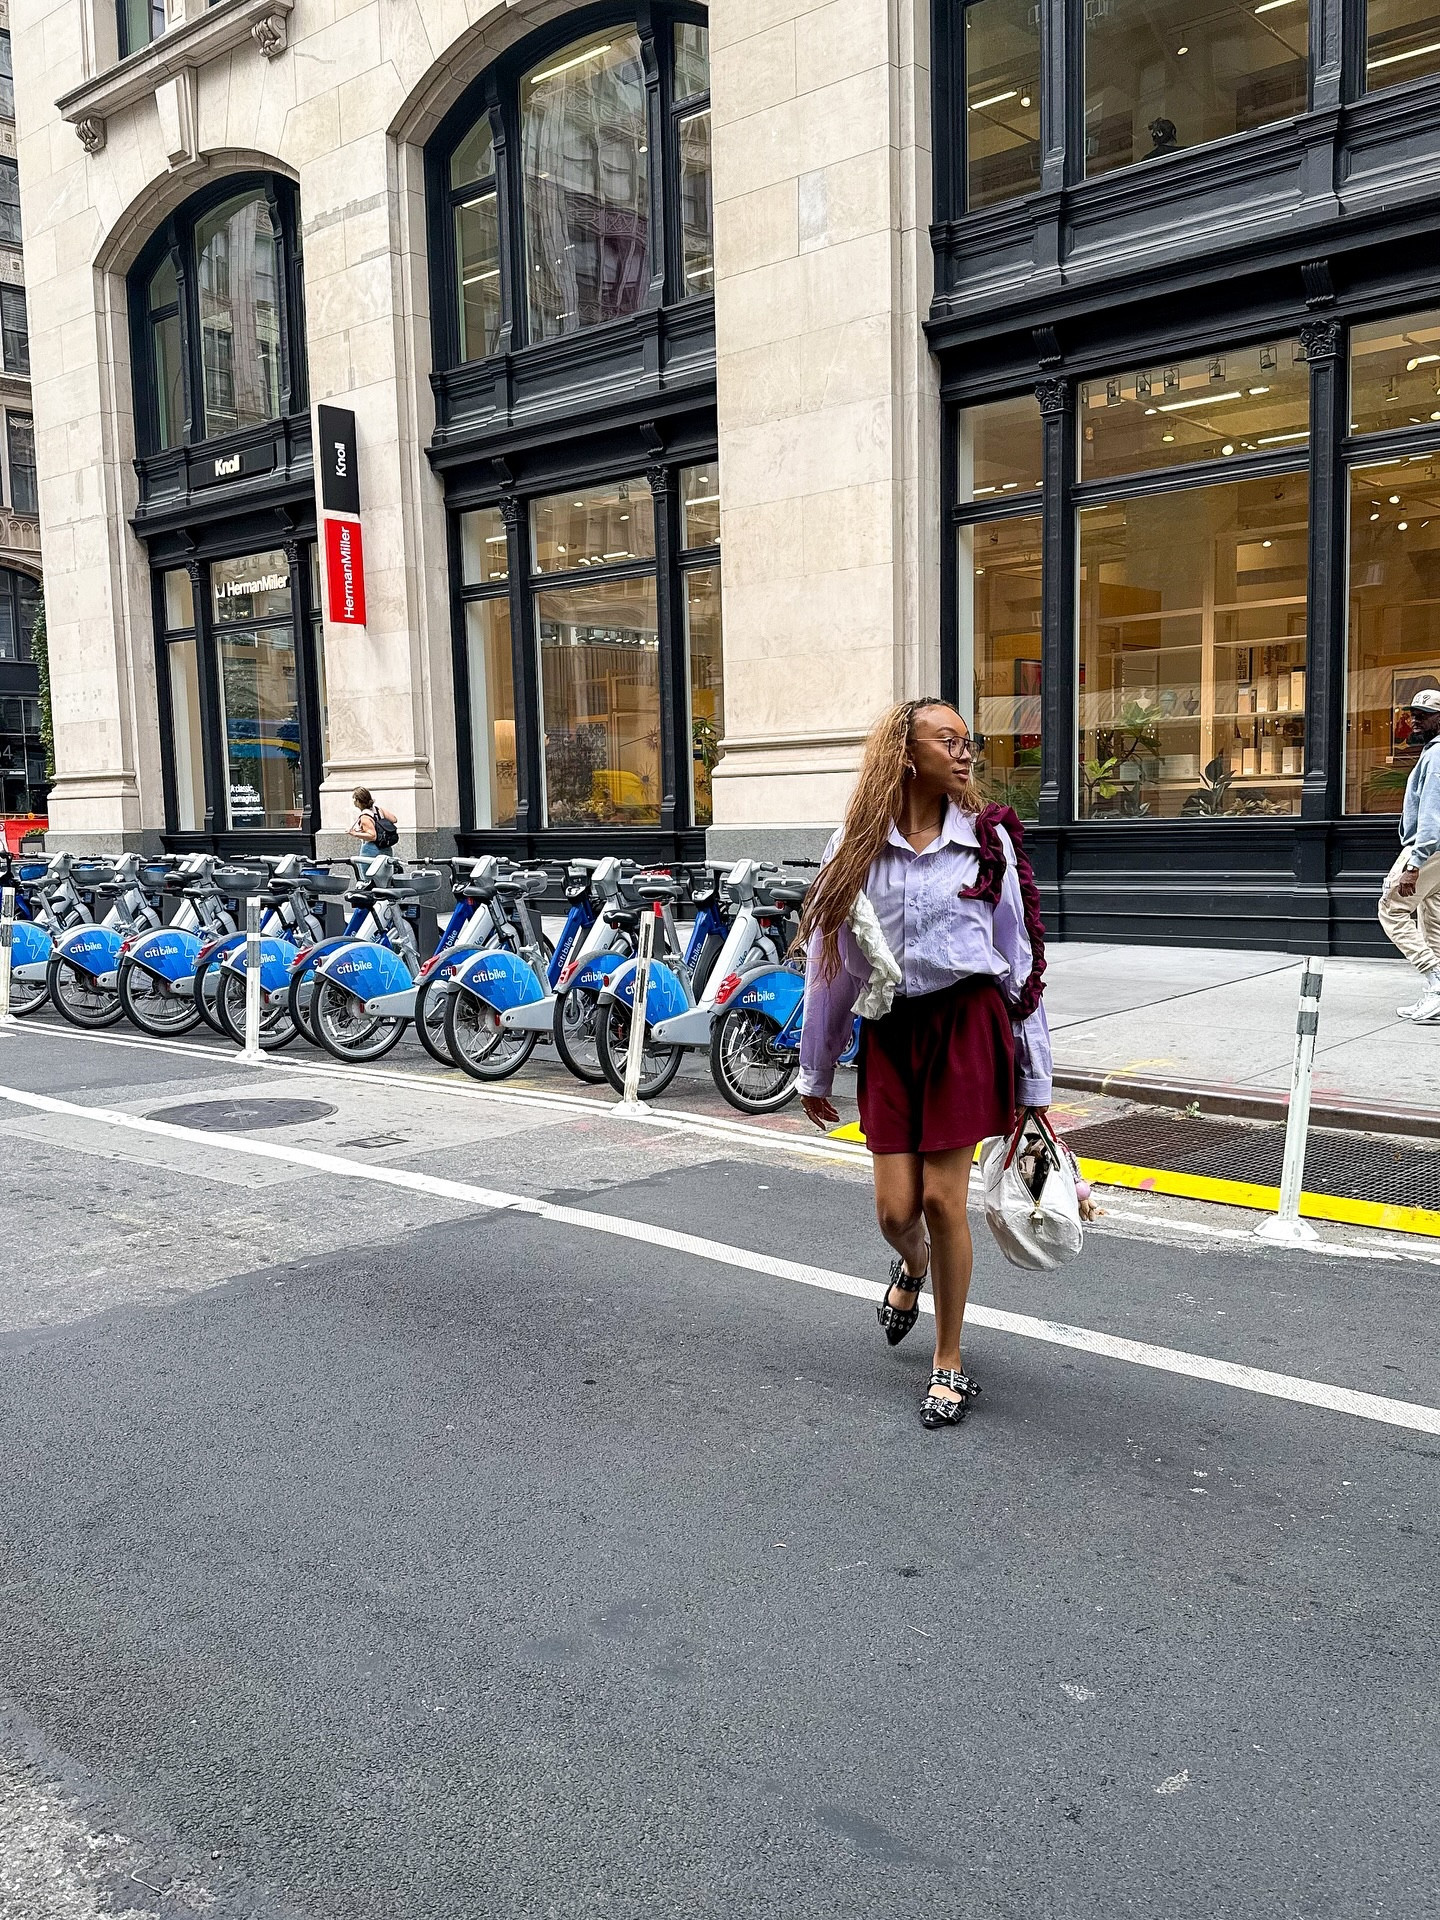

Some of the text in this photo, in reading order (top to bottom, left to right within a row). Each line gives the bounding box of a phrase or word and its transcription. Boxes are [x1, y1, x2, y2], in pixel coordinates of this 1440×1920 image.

[215, 455, 240, 477] Knoll
[334, 442, 347, 477] Knoll
[226, 574, 288, 597] HermanMiller
[340, 526, 355, 619] HermanMiller
